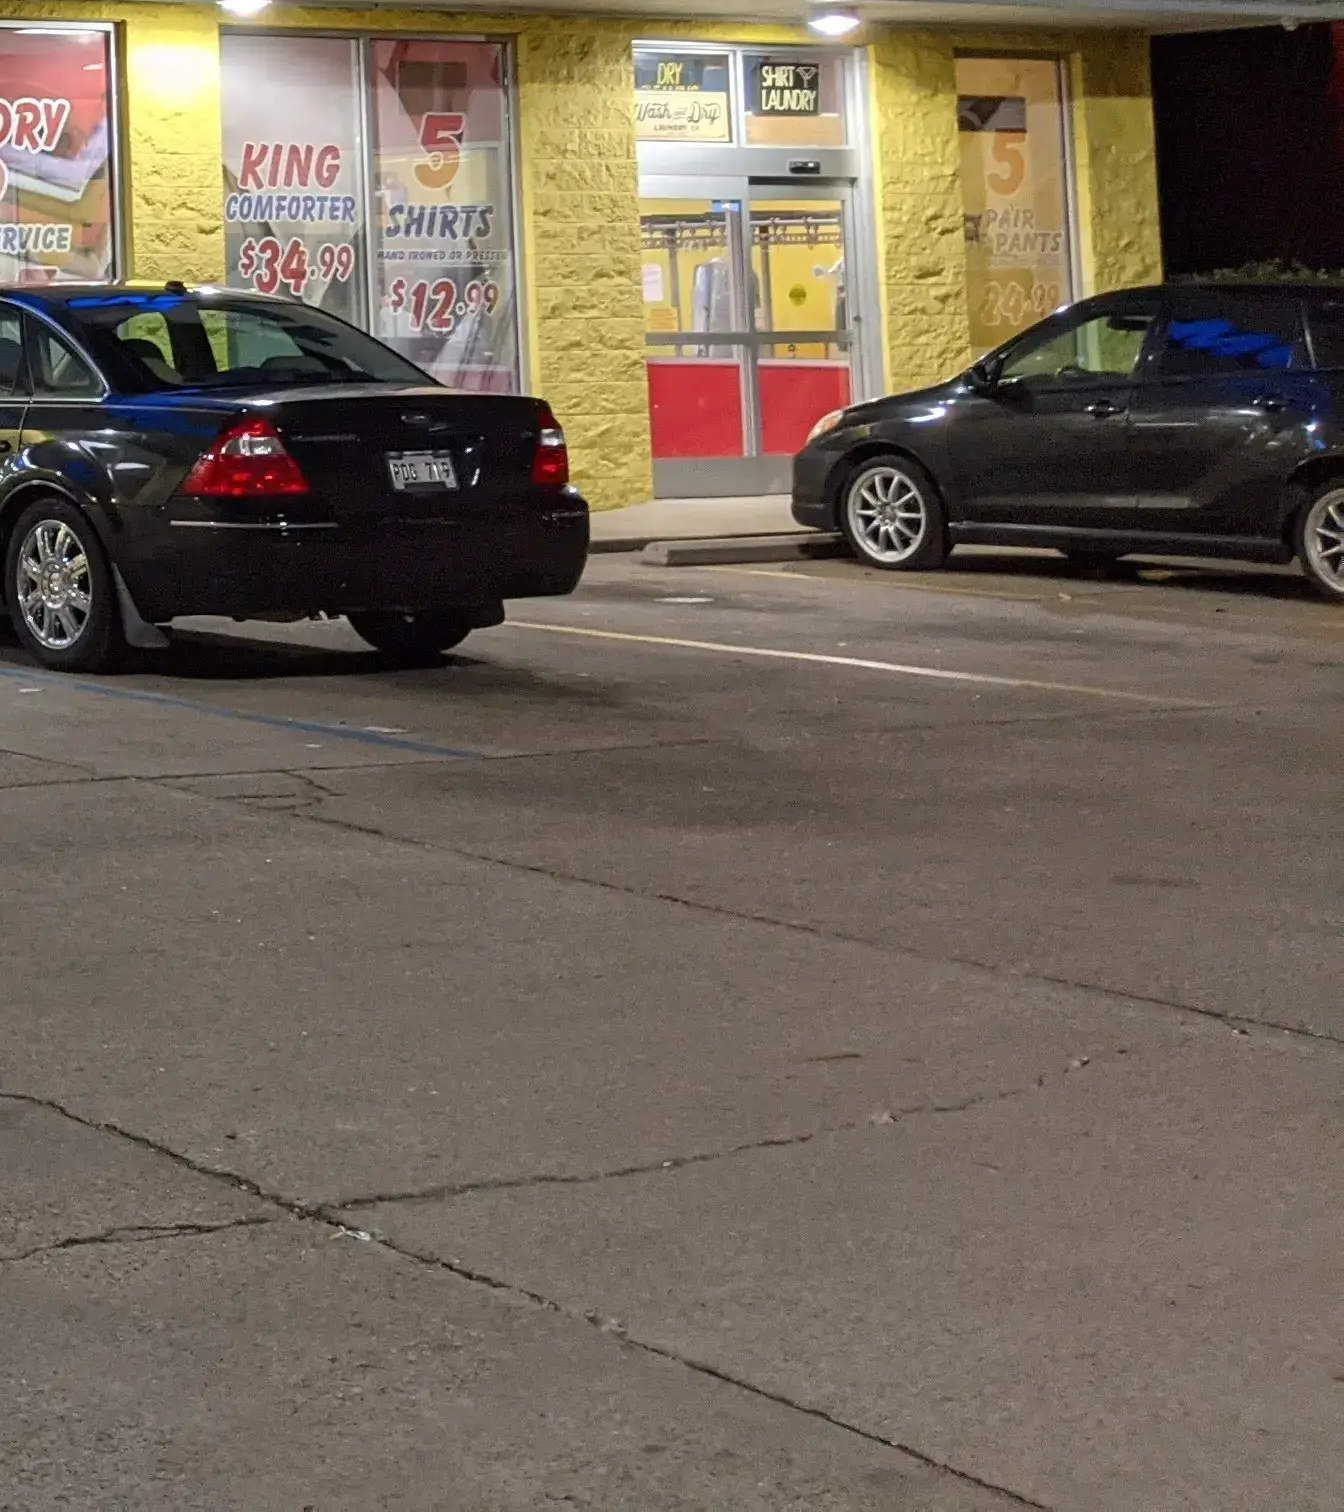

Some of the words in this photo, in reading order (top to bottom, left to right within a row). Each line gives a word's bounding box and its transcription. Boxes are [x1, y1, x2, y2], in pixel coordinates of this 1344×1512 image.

[657, 62, 684, 85] DRY
[762, 66, 796, 87] SHIRT
[762, 89, 816, 111] LAUNDRY
[238, 142, 343, 191] KING
[414, 112, 465, 190] 5
[987, 132, 1027, 195] 5
[225, 194, 356, 223] COMFORTER
[385, 204, 494, 239] SHIRTS
[994, 231, 1062, 253] PANTS
[240, 237, 354, 296] $34.99
[390, 277, 499, 332] $12.99
